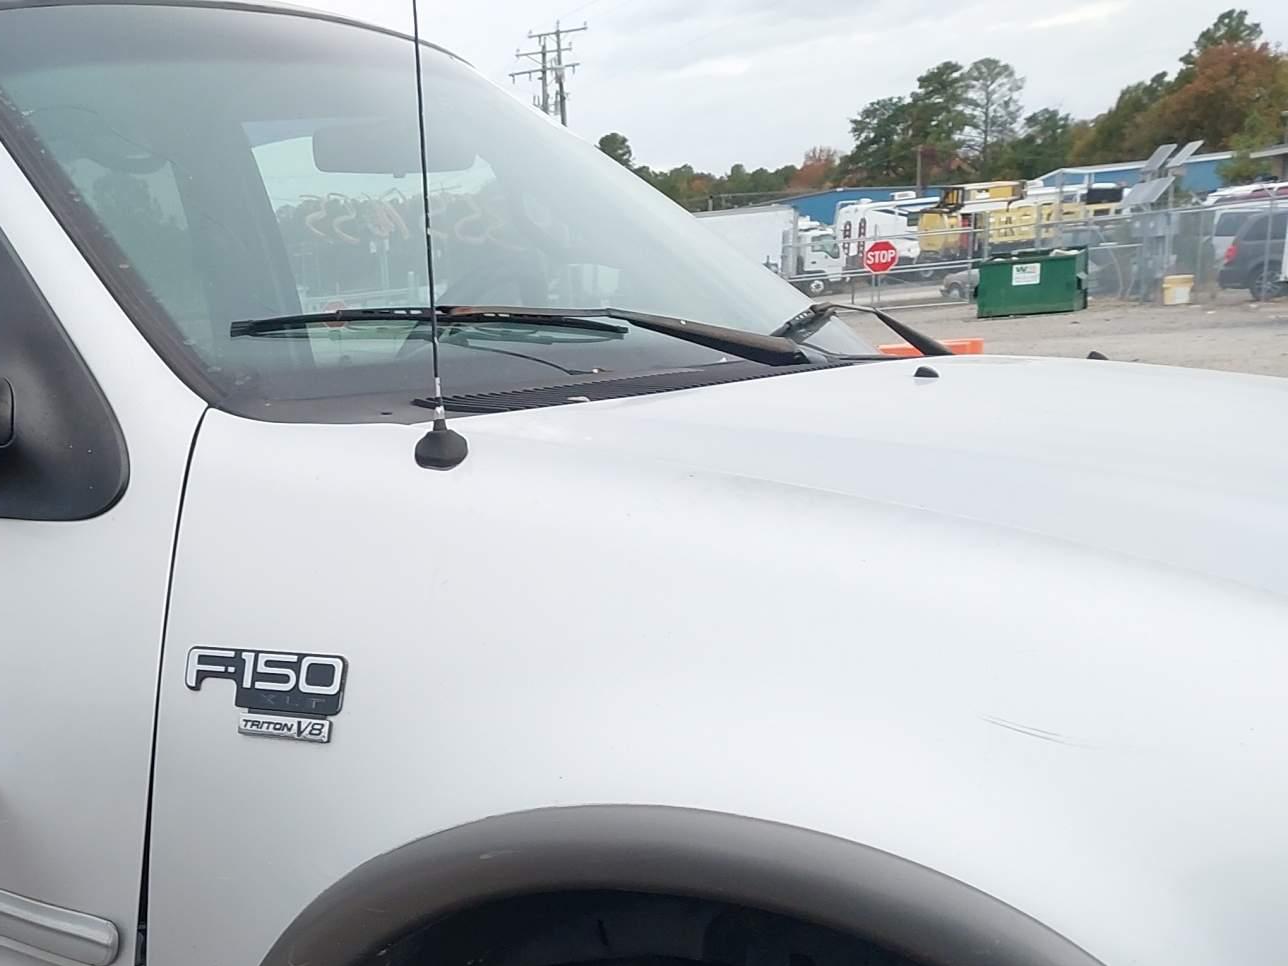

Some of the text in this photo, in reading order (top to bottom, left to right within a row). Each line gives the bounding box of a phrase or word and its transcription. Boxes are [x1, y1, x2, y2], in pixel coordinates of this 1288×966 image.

[866, 249, 896, 265] STOP
[185, 647, 344, 695] F-150
[242, 718, 325, 737] TRITON V8
